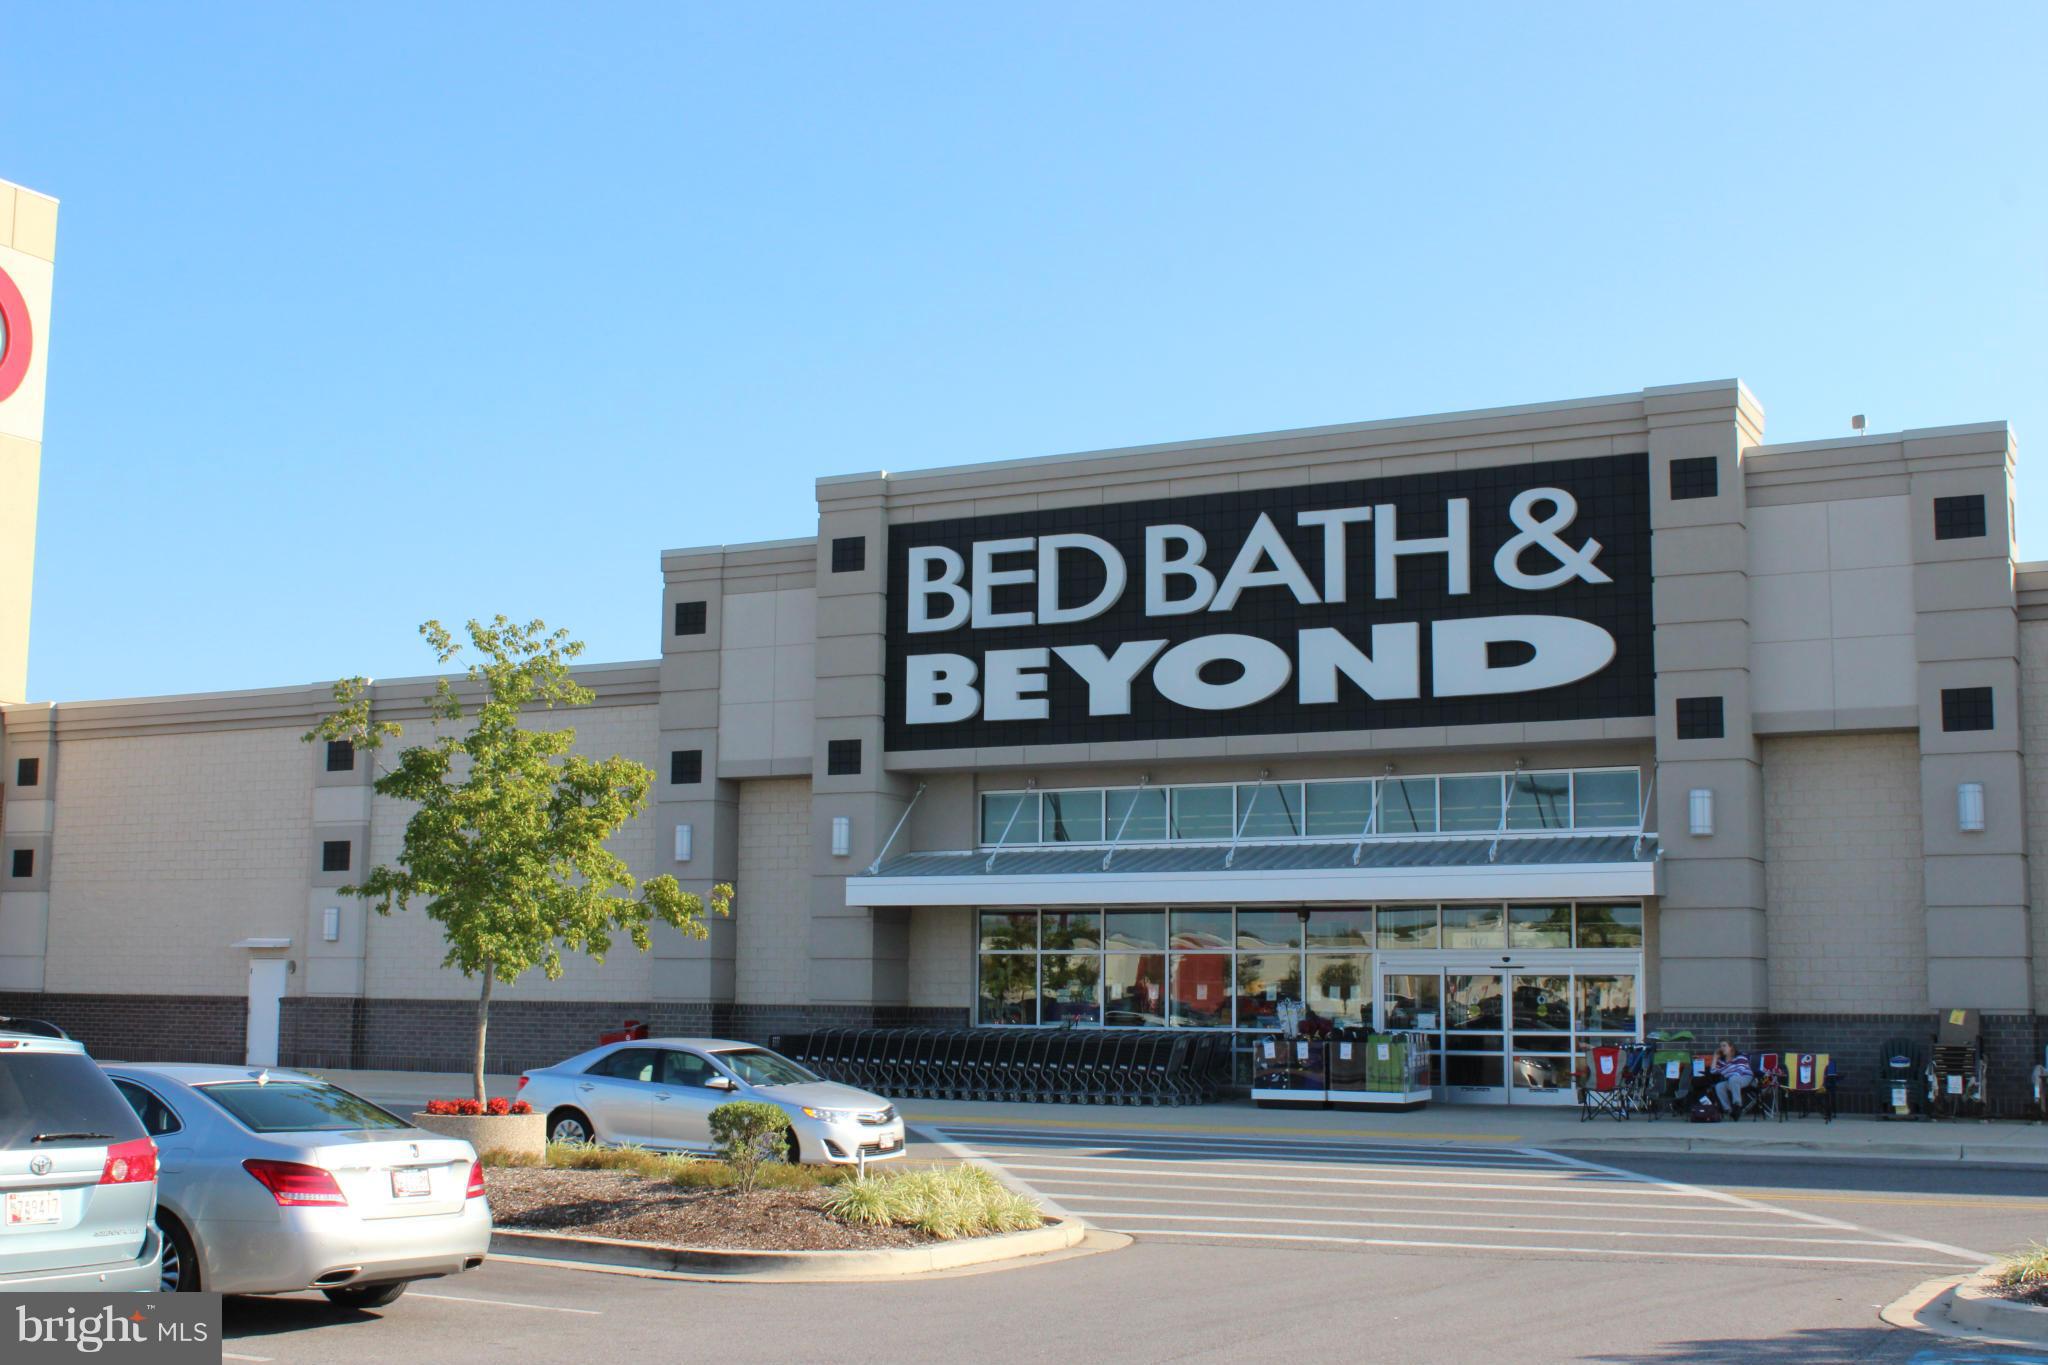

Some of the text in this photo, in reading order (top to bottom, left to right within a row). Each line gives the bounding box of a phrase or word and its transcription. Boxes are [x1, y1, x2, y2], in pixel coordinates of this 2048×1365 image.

[907, 487, 1613, 633] BED BATH &
[905, 614, 1617, 725] BEYOND
